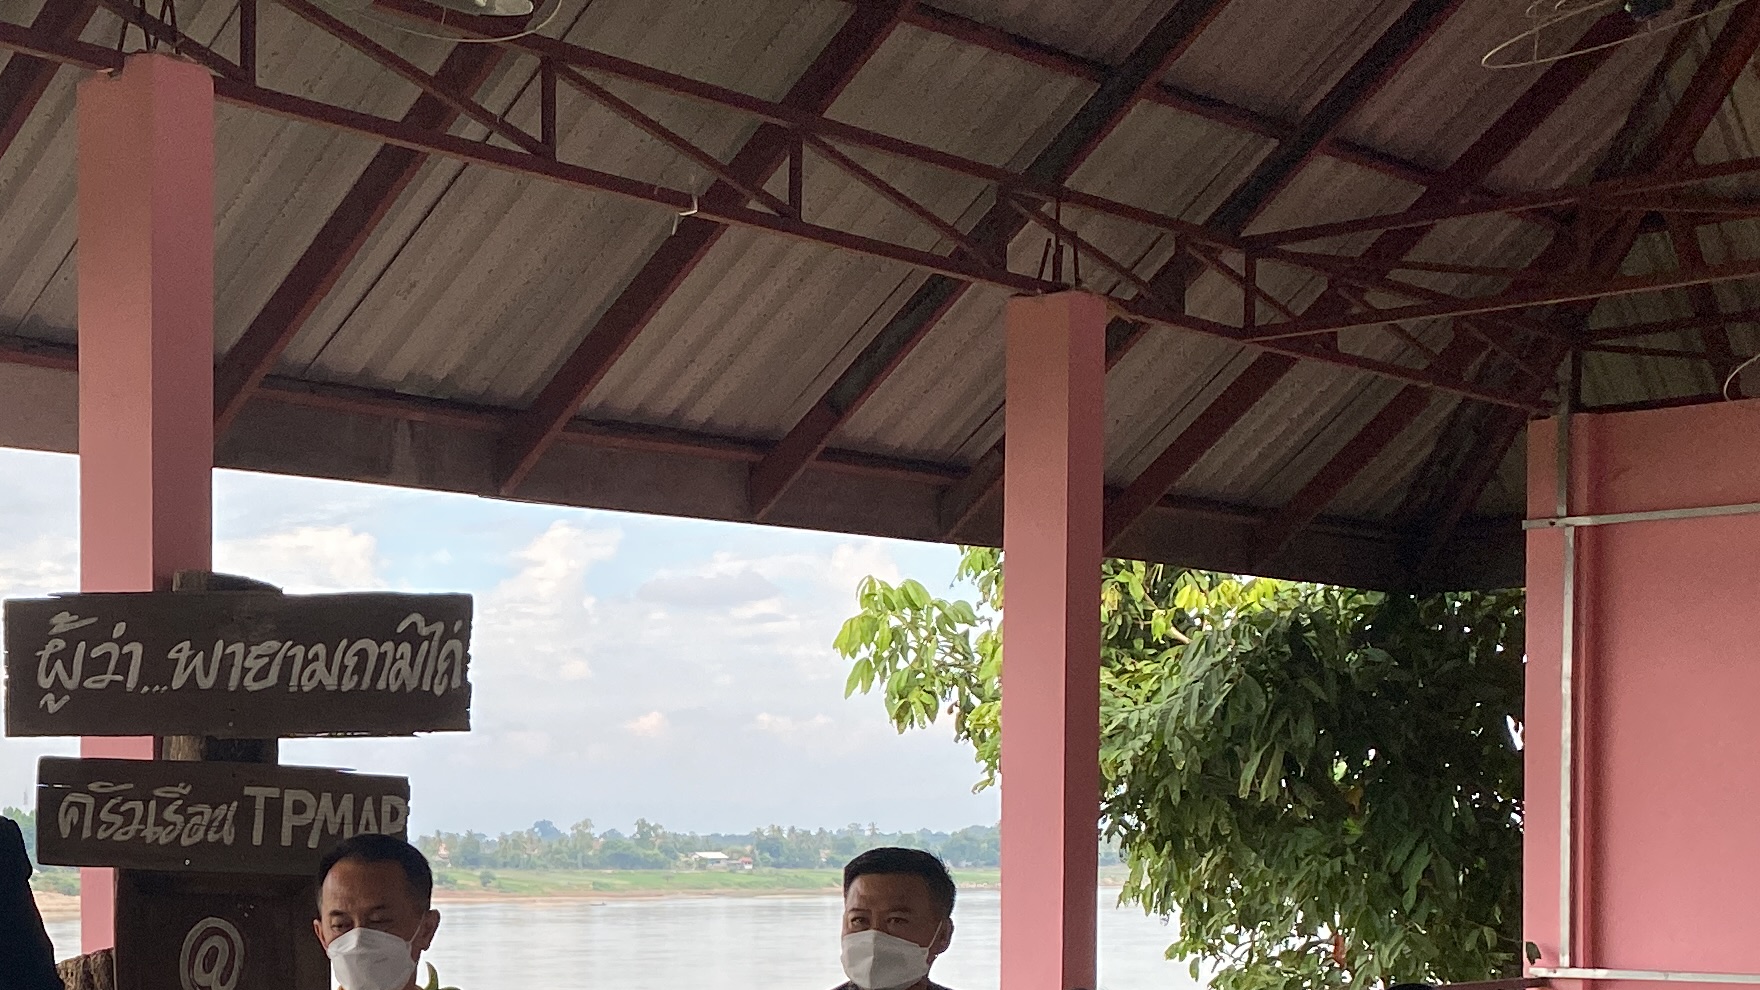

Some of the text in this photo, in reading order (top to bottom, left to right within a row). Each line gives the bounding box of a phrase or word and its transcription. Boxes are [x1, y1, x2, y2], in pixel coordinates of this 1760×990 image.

[57, 781, 409, 849] ครัวเรือน TPMAP
